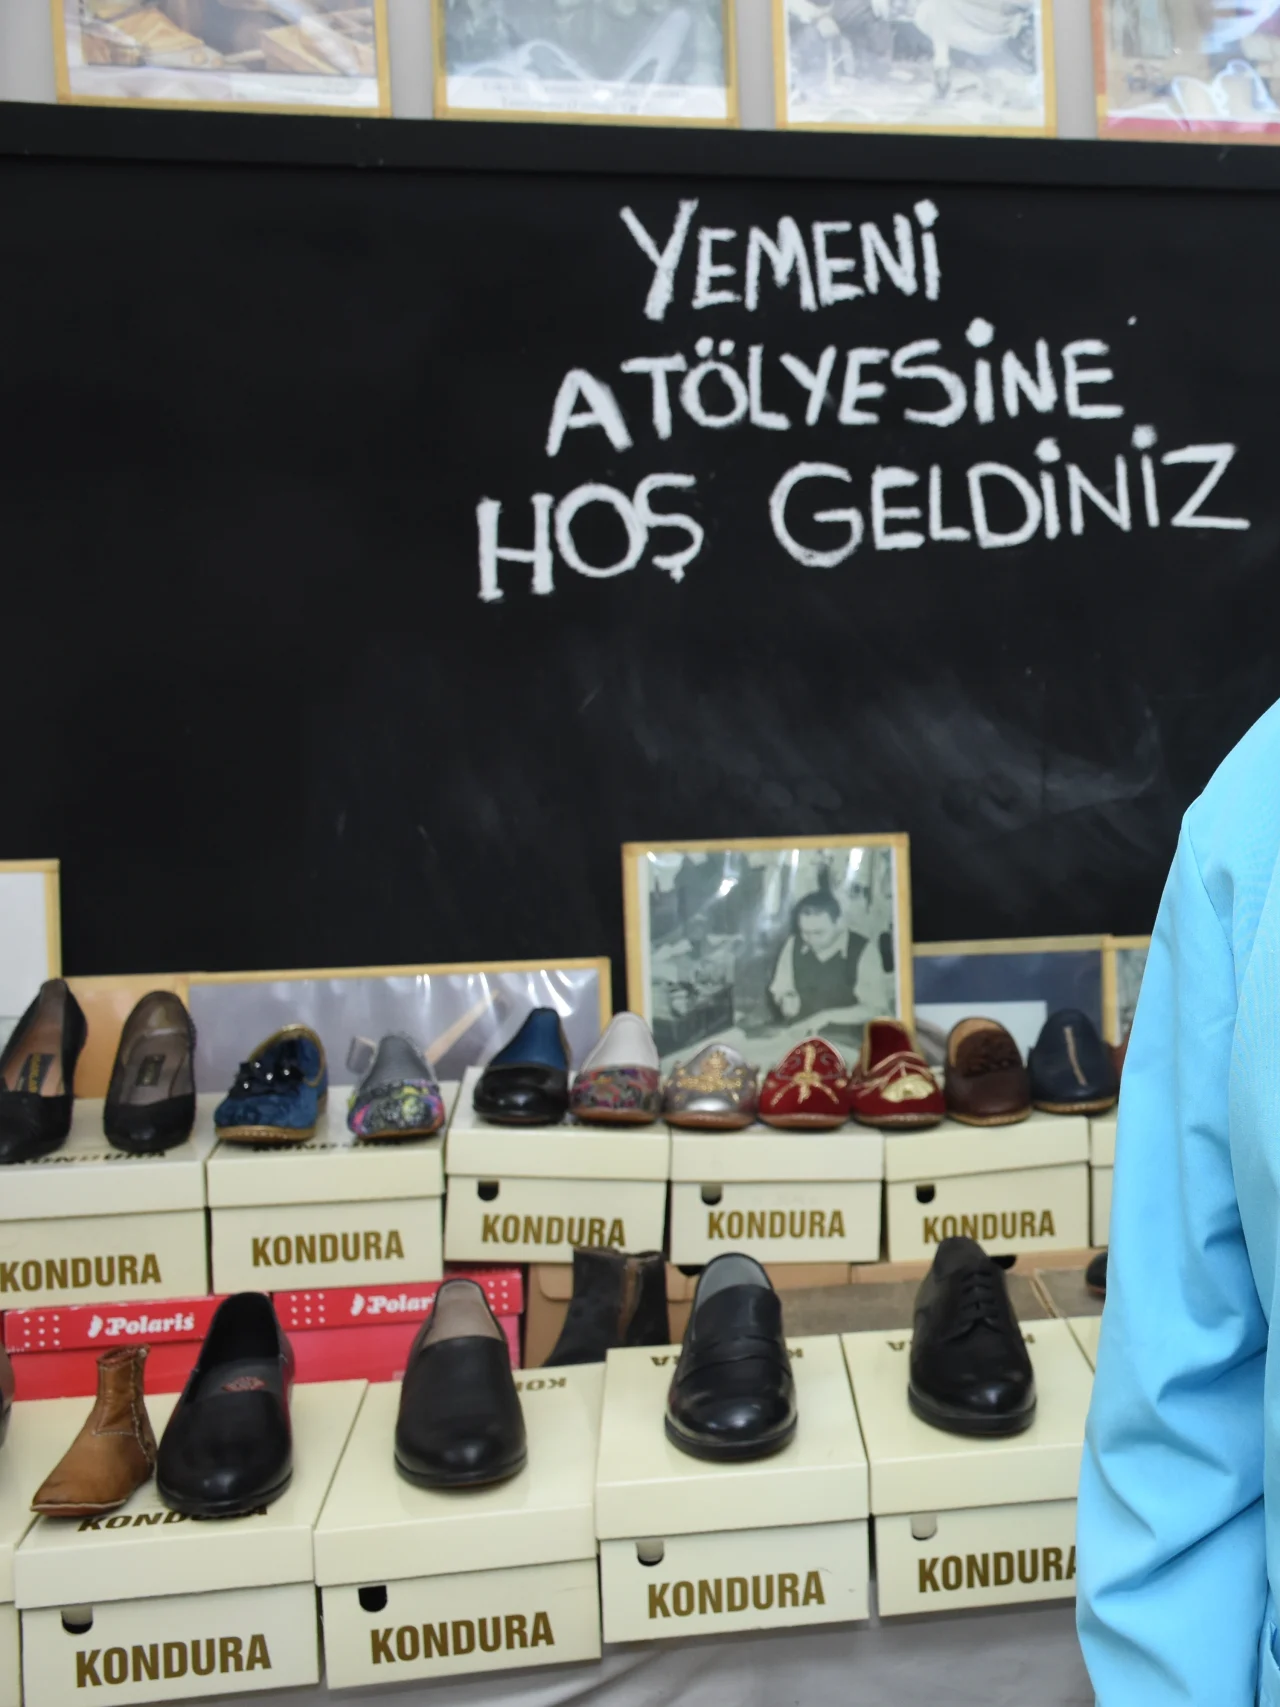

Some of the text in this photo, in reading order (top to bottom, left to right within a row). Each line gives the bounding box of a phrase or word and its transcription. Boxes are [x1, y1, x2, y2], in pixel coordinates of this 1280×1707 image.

[477, 473, 705, 601] HOŞ
[482, 1215, 625, 1246] KONDURA
[708, 1210, 844, 1240] KONDURA
[924, 1210, 1055, 1244] KONDURA
[253, 1231, 404, 1268] KONDURA
[0, 1254, 161, 1294] KONDURA
[367, 1293, 436, 1315] Polar
[106, 1312, 194, 1336] Polaris
[78, 1504, 268, 1532] KOND
[649, 1571, 824, 1618] KONDURA
[371, 1612, 554, 1664] KONDURA
[76, 1634, 271, 1688] KONDURA
